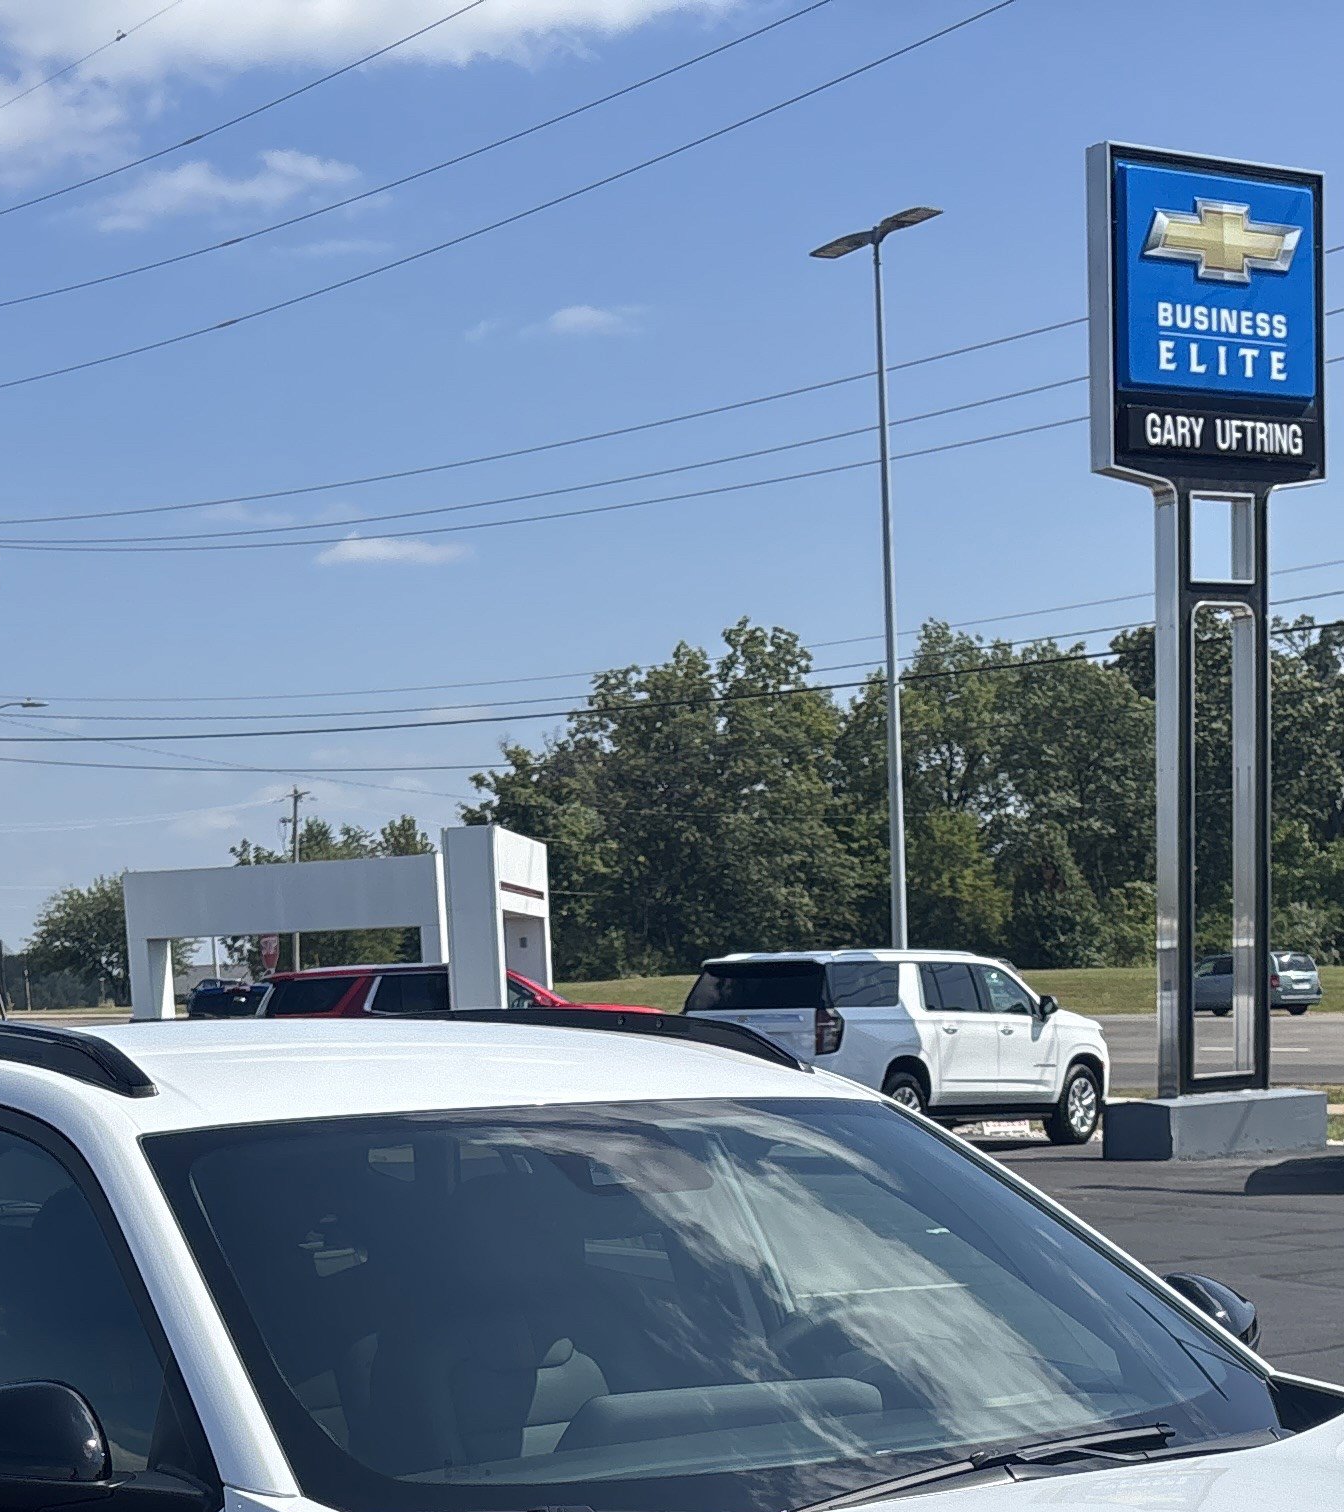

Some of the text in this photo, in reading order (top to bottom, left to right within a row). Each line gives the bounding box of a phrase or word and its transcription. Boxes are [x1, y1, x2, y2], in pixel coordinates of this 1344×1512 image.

[1158, 302, 1287, 338] BUSINESS
[1159, 341, 1287, 381] ELITE
[1145, 413, 1303, 455] GARY UFTRING
